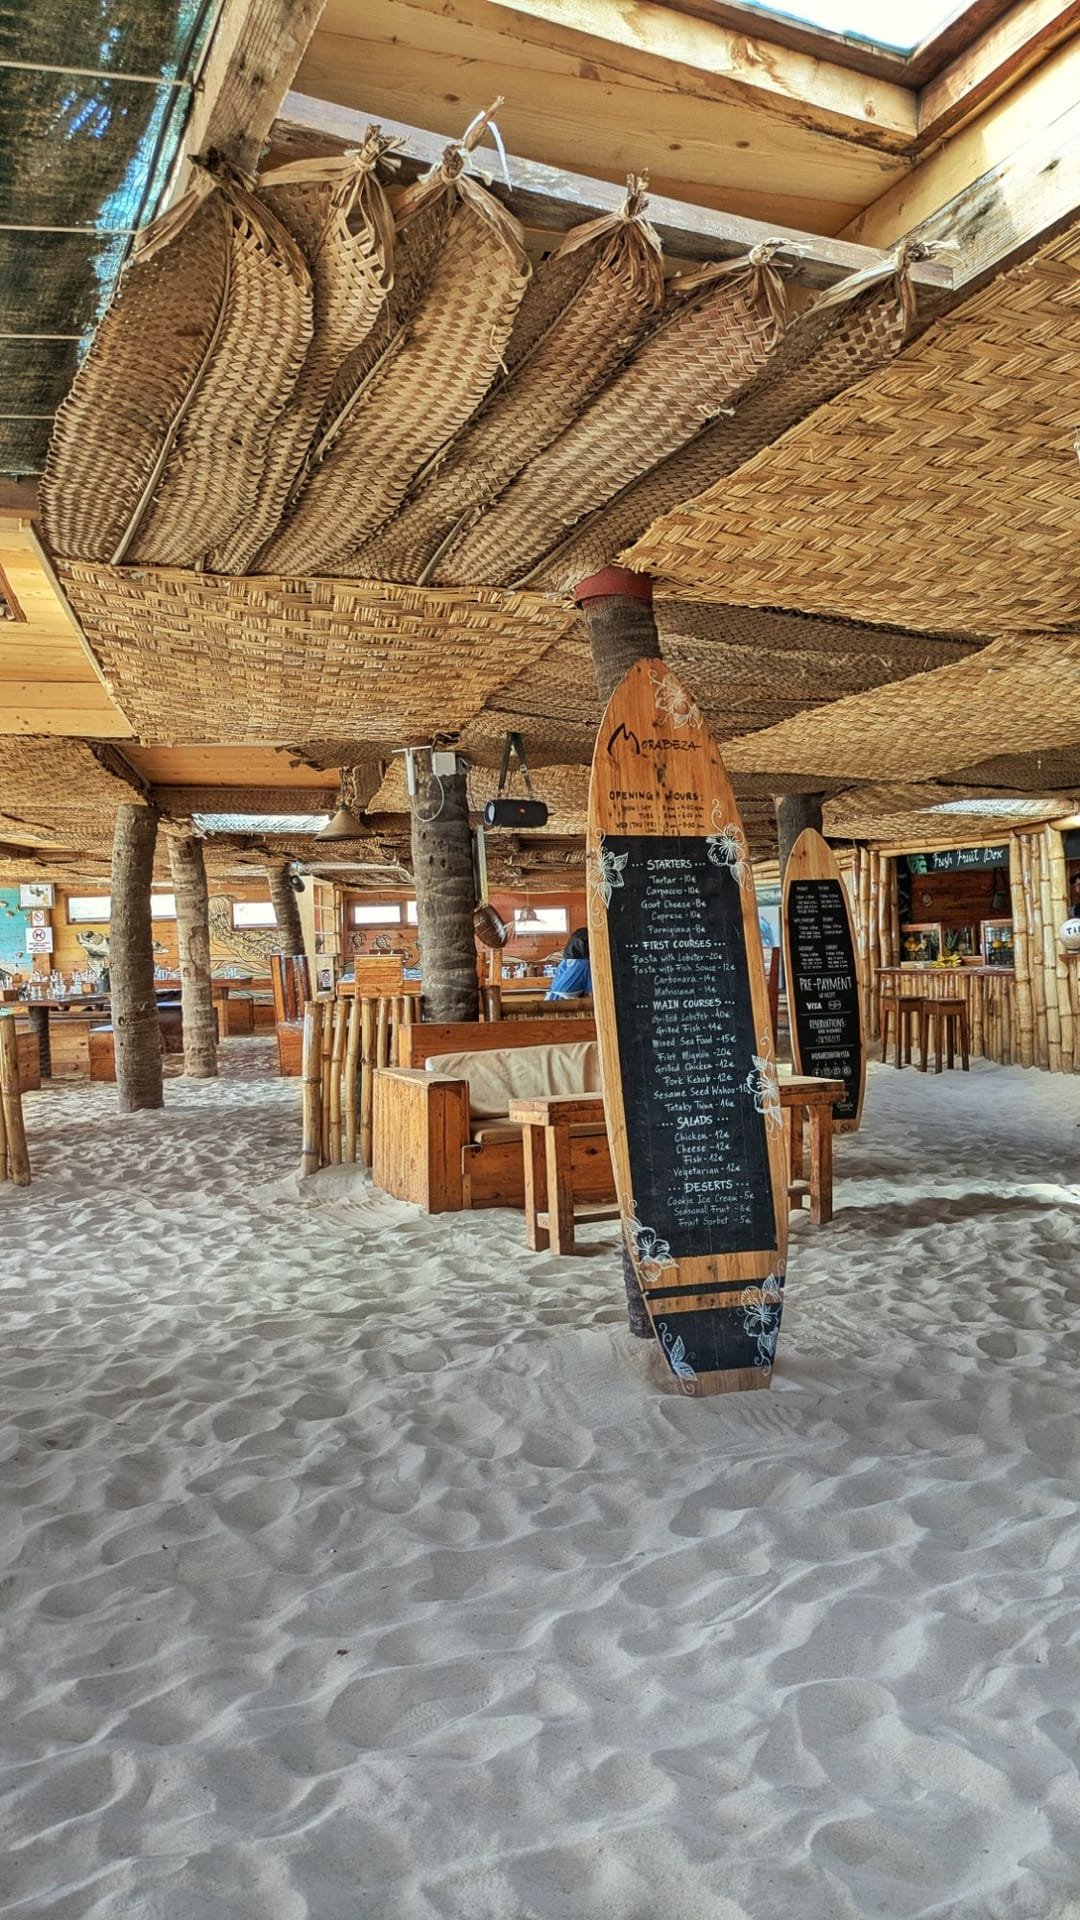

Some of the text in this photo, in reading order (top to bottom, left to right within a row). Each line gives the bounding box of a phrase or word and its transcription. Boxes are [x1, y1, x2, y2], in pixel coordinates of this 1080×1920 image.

[609, 790, 653, 801] OPENING
[957, 848, 979, 867] Fruit
[983, 847, 1004, 863] Box
[646, 859, 692, 871] STARTERS
[648, 875, 676, 884] Tartar
[646, 886, 682, 898] Carpaccio
[641, 900, 660, 910] Goat
[664, 900, 691, 909] Cheese
[651, 911, 683, 923] Caprese
[1066, 926, 1080, 935] TI
[642, 939, 712, 950] FIRST COURSES
[632, 954, 657, 964] Pasta
[661, 952, 675, 962] with
[678, 951, 704, 961] Lobster
[632, 965, 656, 975] Pasta
[659, 965, 674, 973] with
[675, 963, 692, 972] Fish
[696, 963, 716, 972] Sauce
[654, 975, 696, 985] Carbonara
[799, 976, 852, 992] PRE-PAYMENT
[653, 998, 721, 1010] MAIN COURSES
[652, 1013, 678, 1024] Grilled
[682, 1012, 709, 1022] Lobster
[656, 1025, 679, 1036] Grilled
[682, 1023, 700, 1033] Fish
[652, 1038, 675, 1048] Mixed
[655, 1064, 680, 1074] Grilled
[685, 1061, 713, 1071] Chicken
[663, 1076, 684, 1086] Pork
[687, 1074, 711, 1084] Kebab
[653, 1090, 687, 1099] Sesame
[690, 1086, 709, 1096] Seed
[664, 1102, 692, 1113] Tataky
[694, 1100, 713, 1110] Tuna
[676, 1115, 713, 1130] SALADS
[674, 1131, 708, 1143] Chicken
[676, 1143, 706, 1154] Cheese
[683, 1154, 702, 1165] Fish
[673, 1167, 719, 1180] Vegetarian
[685, 1180, 733, 1193] DESERTS
[697, 1194, 711, 1204] Ice
[715, 1194, 738, 1203] Cream
[673, 1204, 707, 1216] Seasonal
[710, 1204, 731, 1213] Fruit
[678, 1217, 699, 1227] Fruit
[703, 1215, 728, 1226] Sorbet
